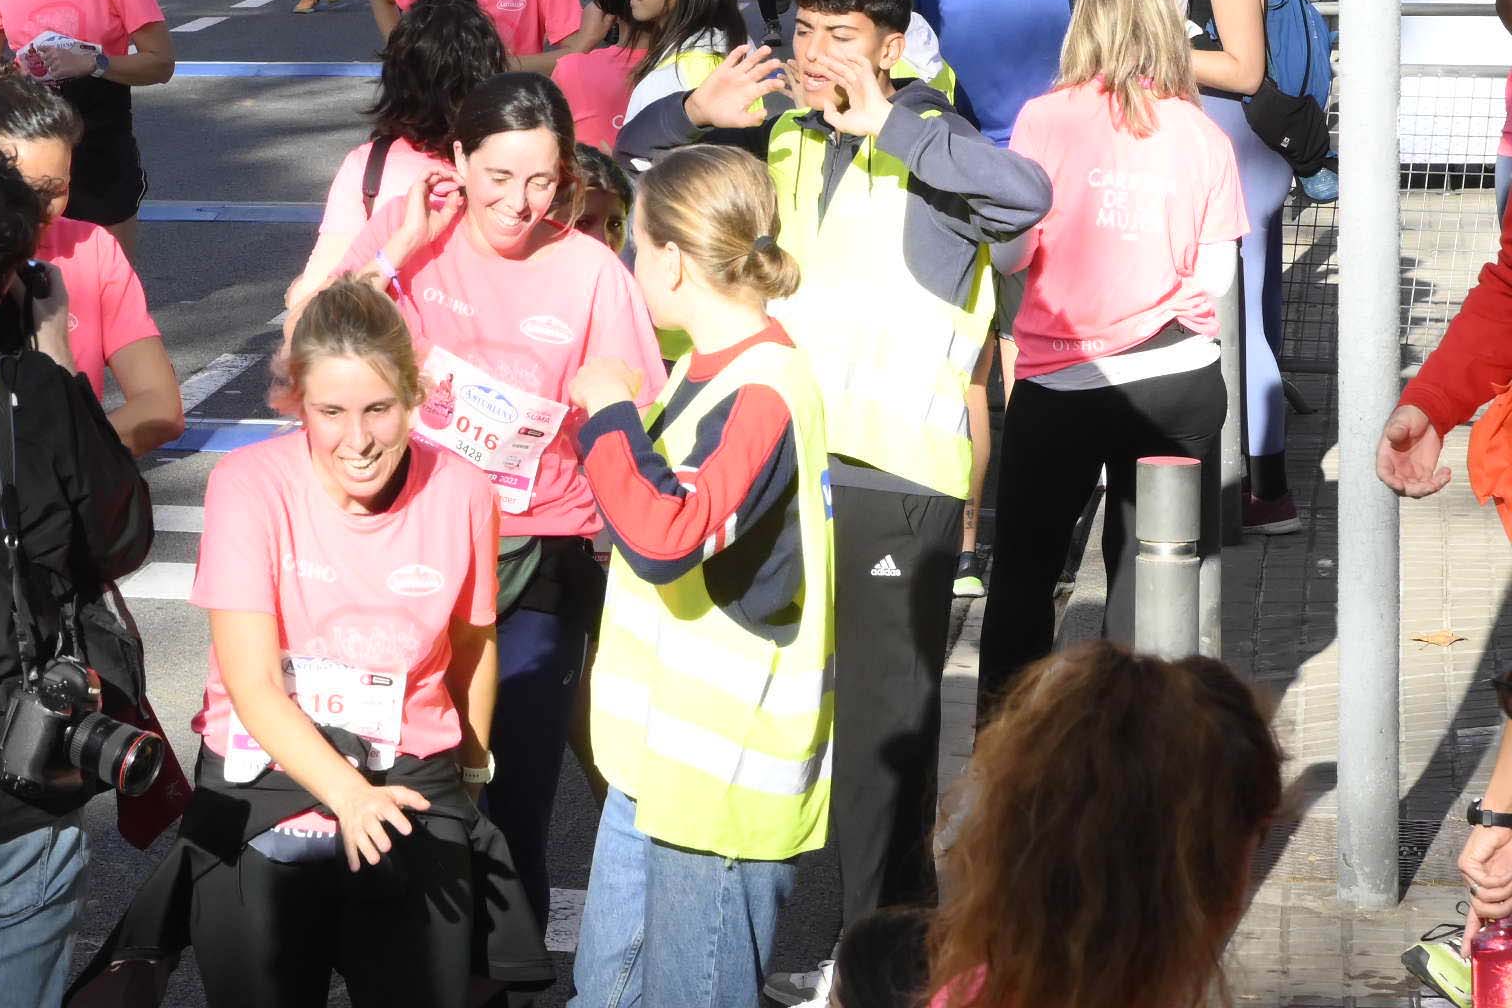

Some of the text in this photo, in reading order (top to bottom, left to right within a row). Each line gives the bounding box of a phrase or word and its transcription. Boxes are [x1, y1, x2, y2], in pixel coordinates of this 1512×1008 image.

[455, 414, 500, 452] 016
[455, 439, 483, 463] 3428
[870, 568, 902, 577] adidas
[311, 694, 345, 714] 16
